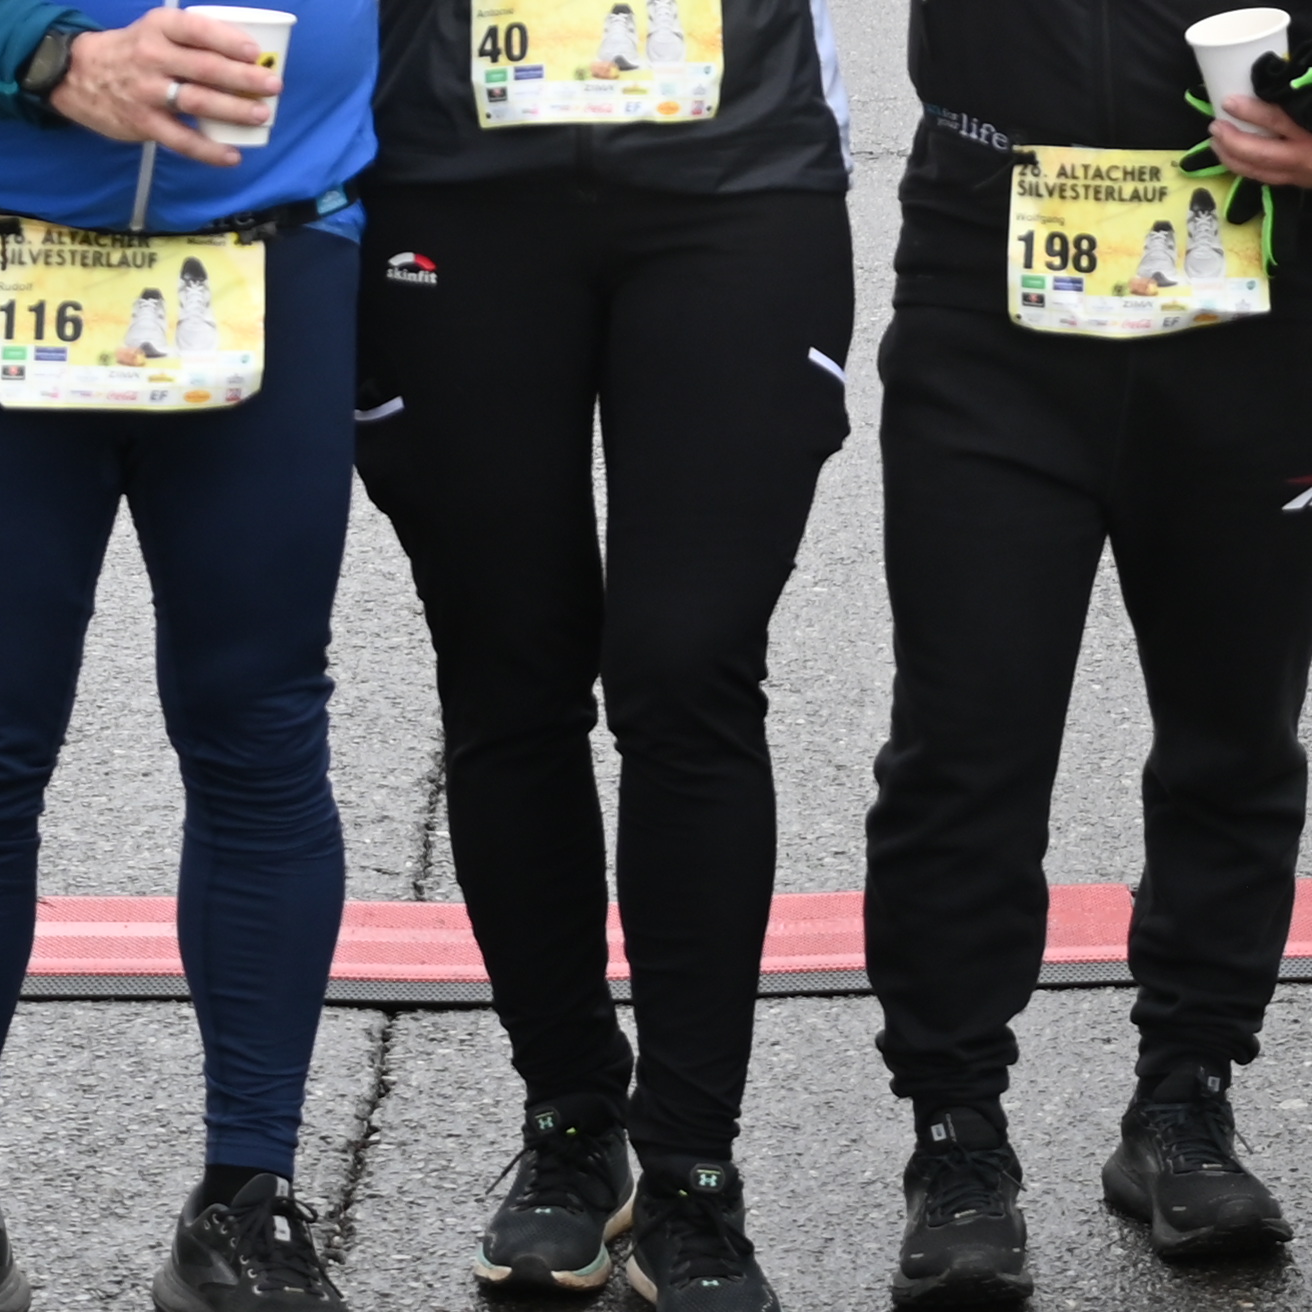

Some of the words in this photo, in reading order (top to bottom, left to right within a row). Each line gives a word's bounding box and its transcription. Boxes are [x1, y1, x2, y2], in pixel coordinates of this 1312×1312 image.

[478, 22, 529, 64] 40
[959, 112, 1009, 150] life
[1056, 163, 1162, 183] ALTACHER
[1016, 180, 1169, 203] SILVESTERLAUF
[41, 230, 151, 248] ALTACHER
[1018, 229, 1098, 274] 198
[386, 266, 438, 286] skinfit
